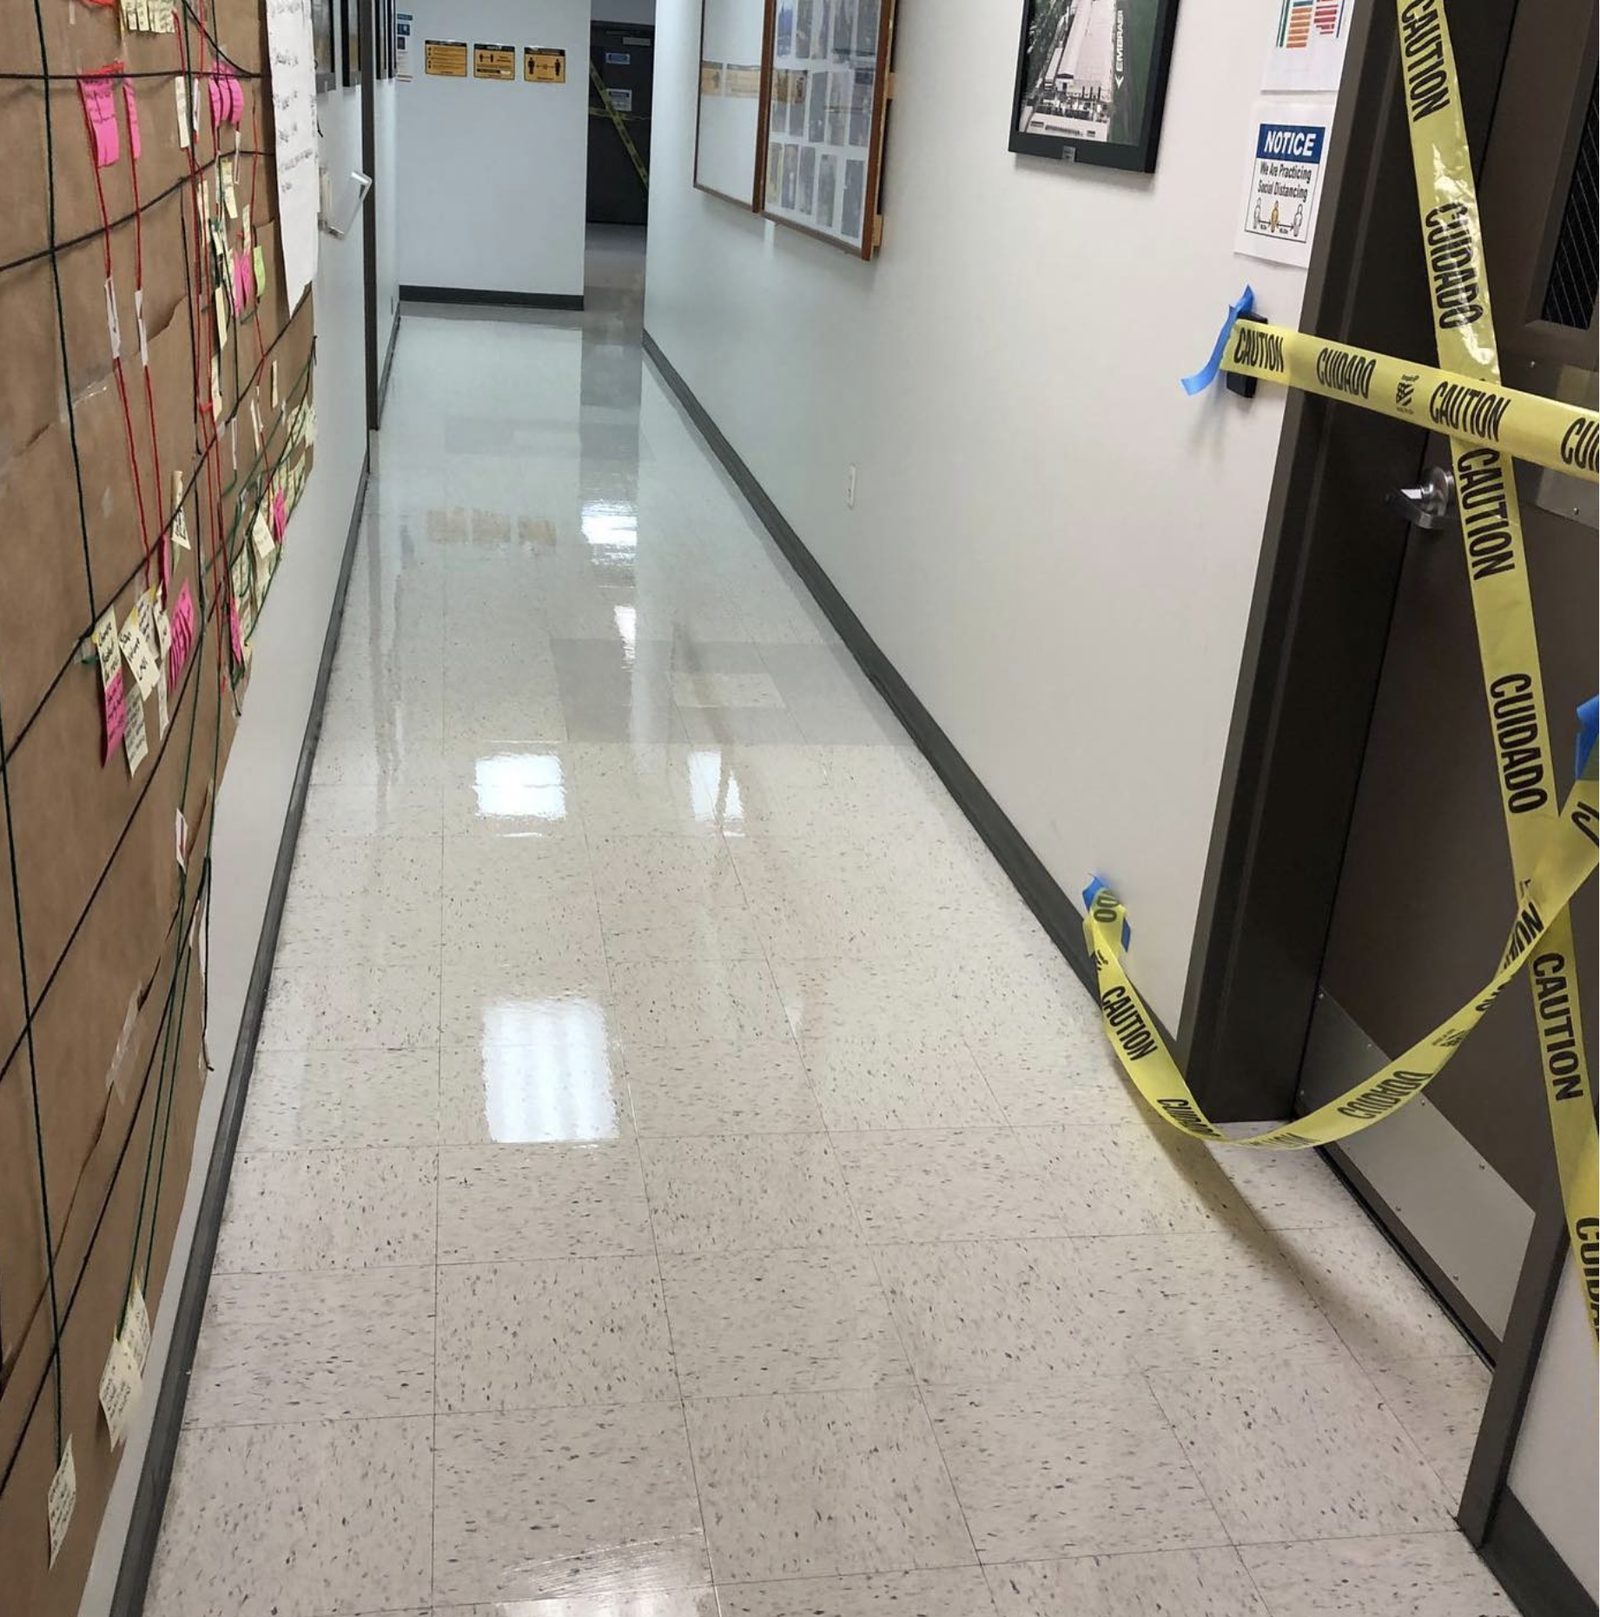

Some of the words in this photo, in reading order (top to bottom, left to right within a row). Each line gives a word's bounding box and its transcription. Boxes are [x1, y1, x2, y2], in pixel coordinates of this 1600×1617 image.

[1401, 0, 1450, 122] CAUTION
[1258, 180, 1274, 195] Social
[1274, 182, 1308, 202] Distancing
[1260, 162, 1268, 174] We
[1269, 164, 1278, 176] Are
[1279, 164, 1312, 184] Practicing
[1264, 130, 1316, 157] NOTICE
[1425, 202, 1483, 329] CUIDADO
[1233, 327, 1284, 373] CAUTION
[1316, 346, 1376, 399] CUIDADO
[1428, 381, 1510, 442] CAUTION
[1560, 417, 1599, 473] CUI
[1457, 449, 1514, 580] CAUTION
[1490, 673, 1548, 813] CUIDADO
[1533, 953, 1584, 1101] CAUTION
[1101, 986, 1158, 1062] CAUTION
